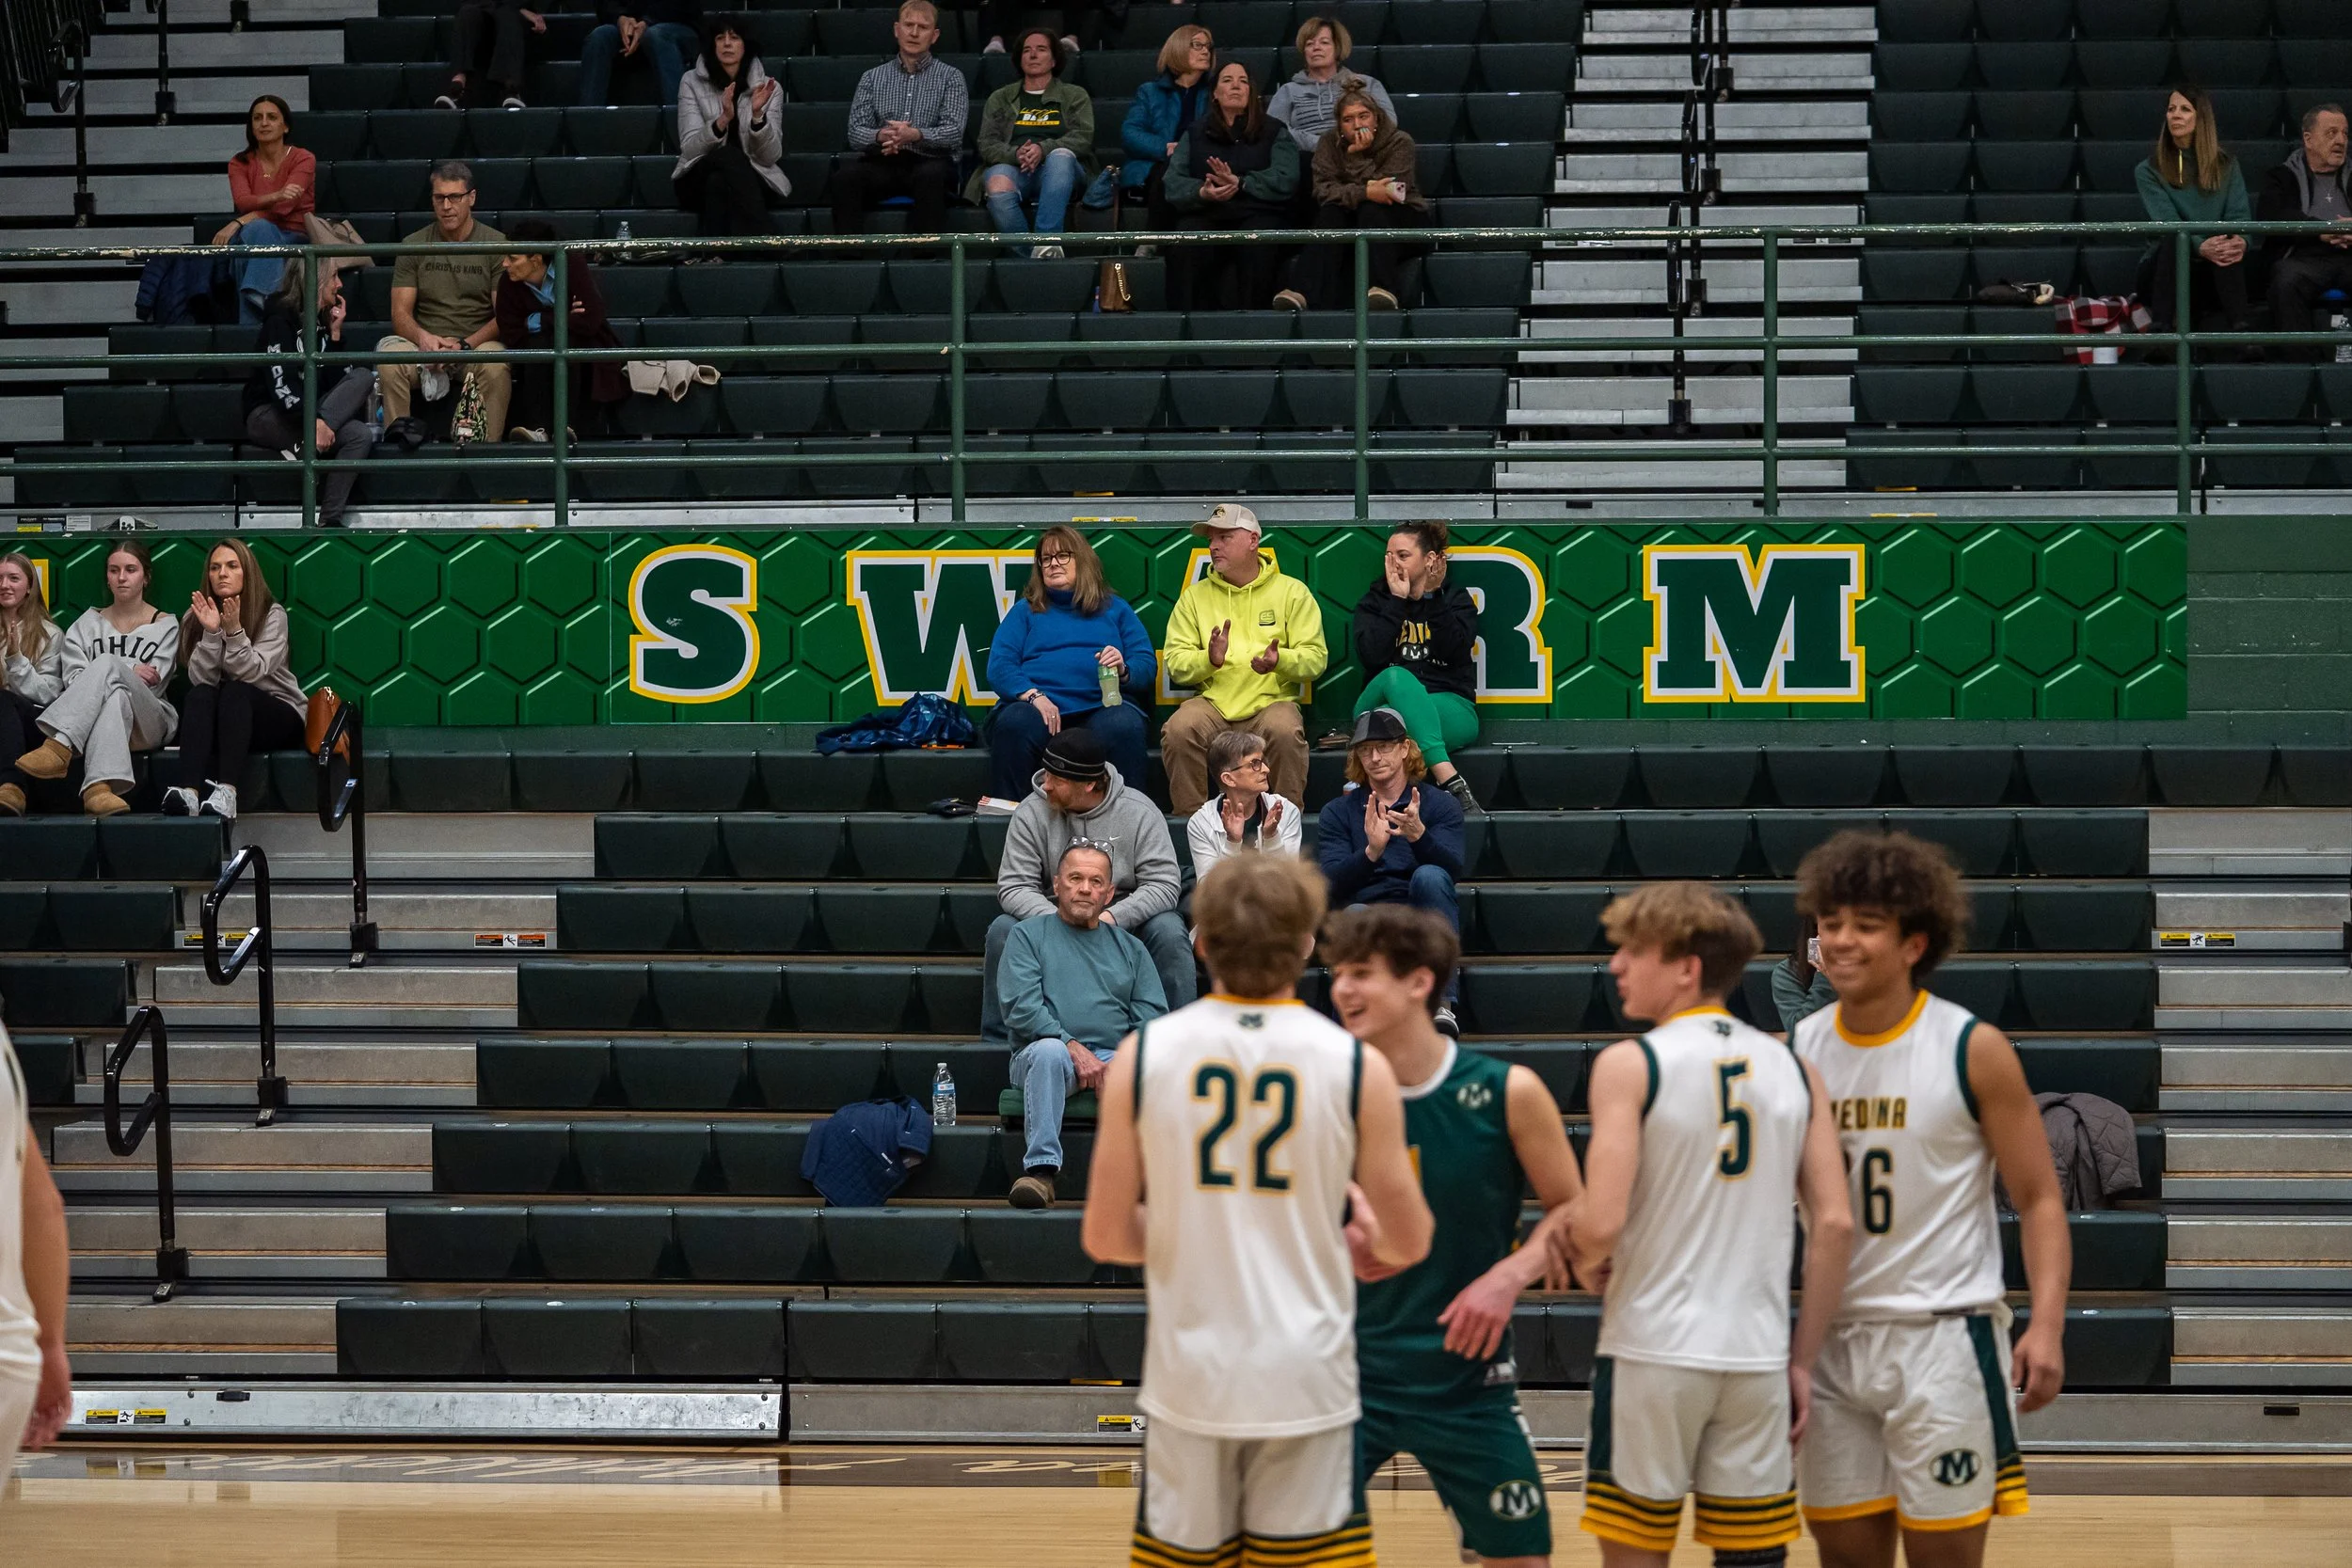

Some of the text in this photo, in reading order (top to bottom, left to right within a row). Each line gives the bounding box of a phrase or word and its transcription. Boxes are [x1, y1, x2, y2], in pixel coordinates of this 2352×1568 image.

[463, 264, 484, 276] KING
[267, 343, 301, 409] MDINA
[91, 634, 159, 664] OHIO
[1193, 1060, 1300, 1193] 22
[1716, 1057, 1753, 1180] 5
[1843, 1147, 1893, 1236] 6
